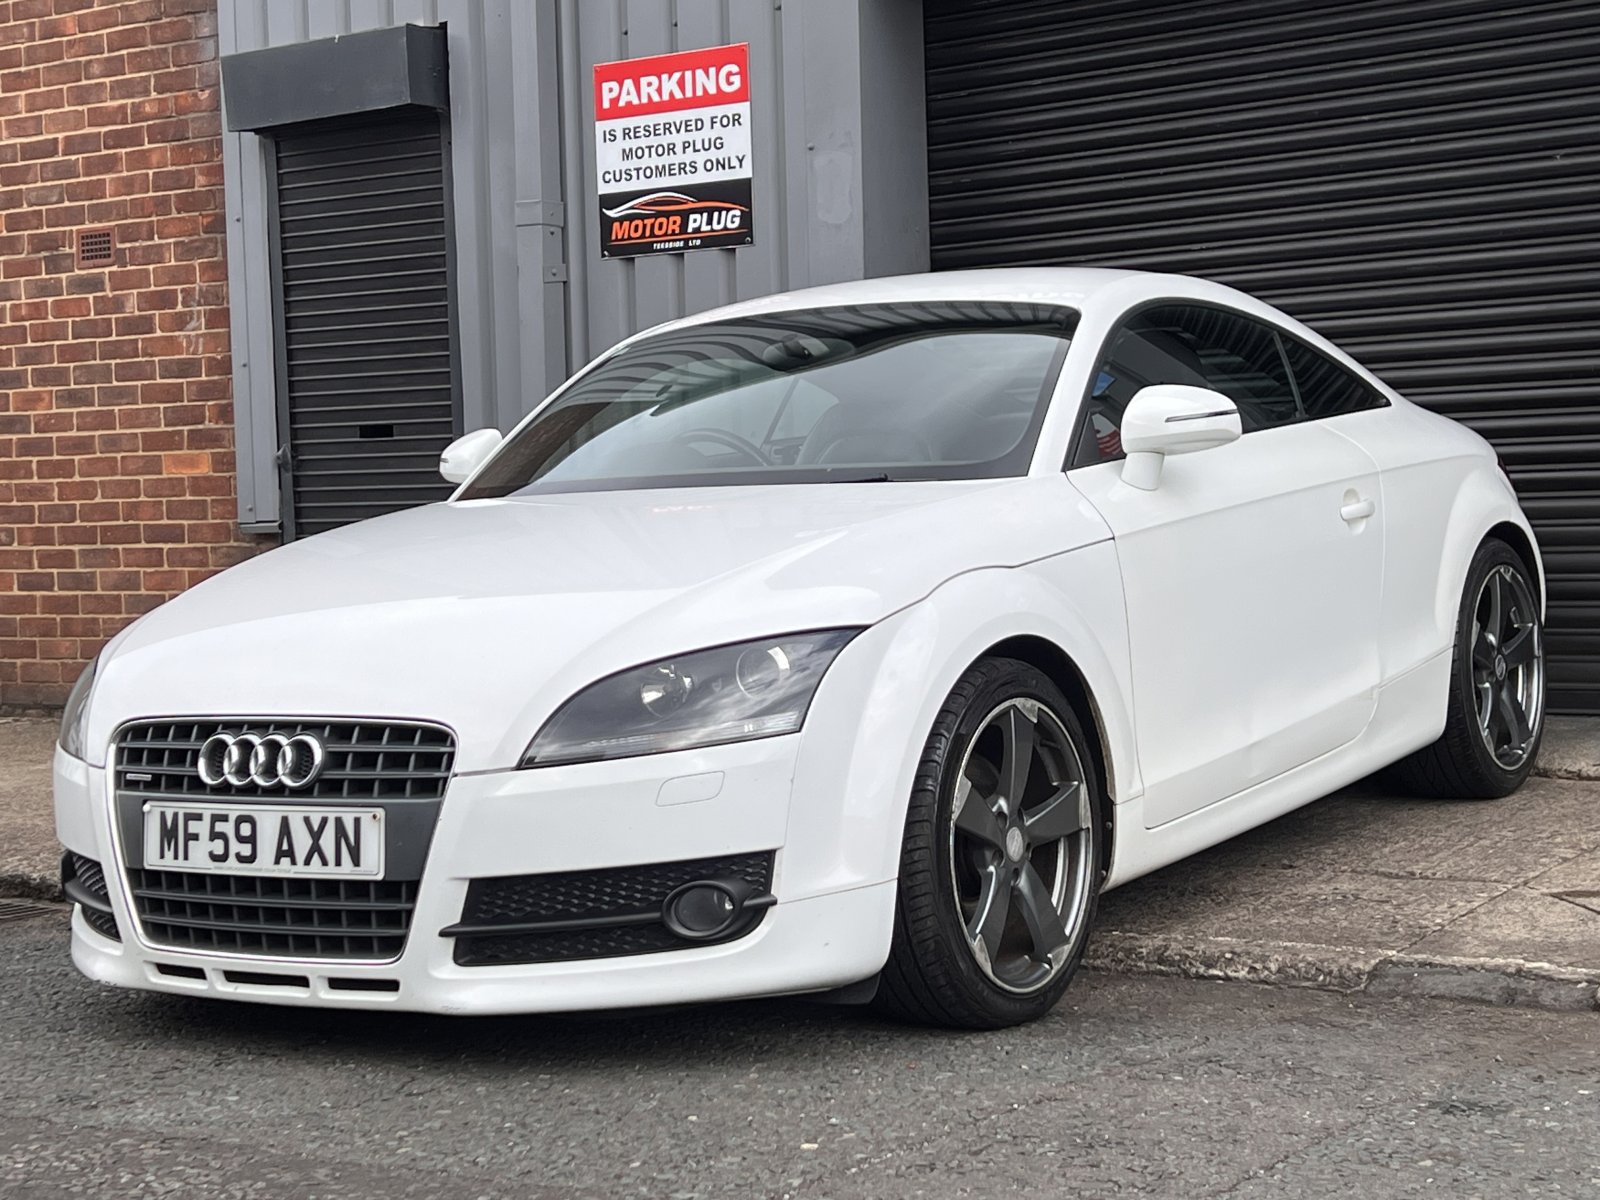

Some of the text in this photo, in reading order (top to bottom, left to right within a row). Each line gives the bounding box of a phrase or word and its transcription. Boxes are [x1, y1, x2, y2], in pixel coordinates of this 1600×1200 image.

[601, 63, 742, 109] PARKING
[602, 113, 742, 143] IS RESERVED FOR
[621, 136, 725, 161] MOTOR PLUG
[602, 154, 746, 184] CUSTOMERS ONLY
[611, 209, 742, 241] MOTOR PLUG
[688, 239, 701, 247] LTD
[159, 810, 362, 868] MF59 AXN
